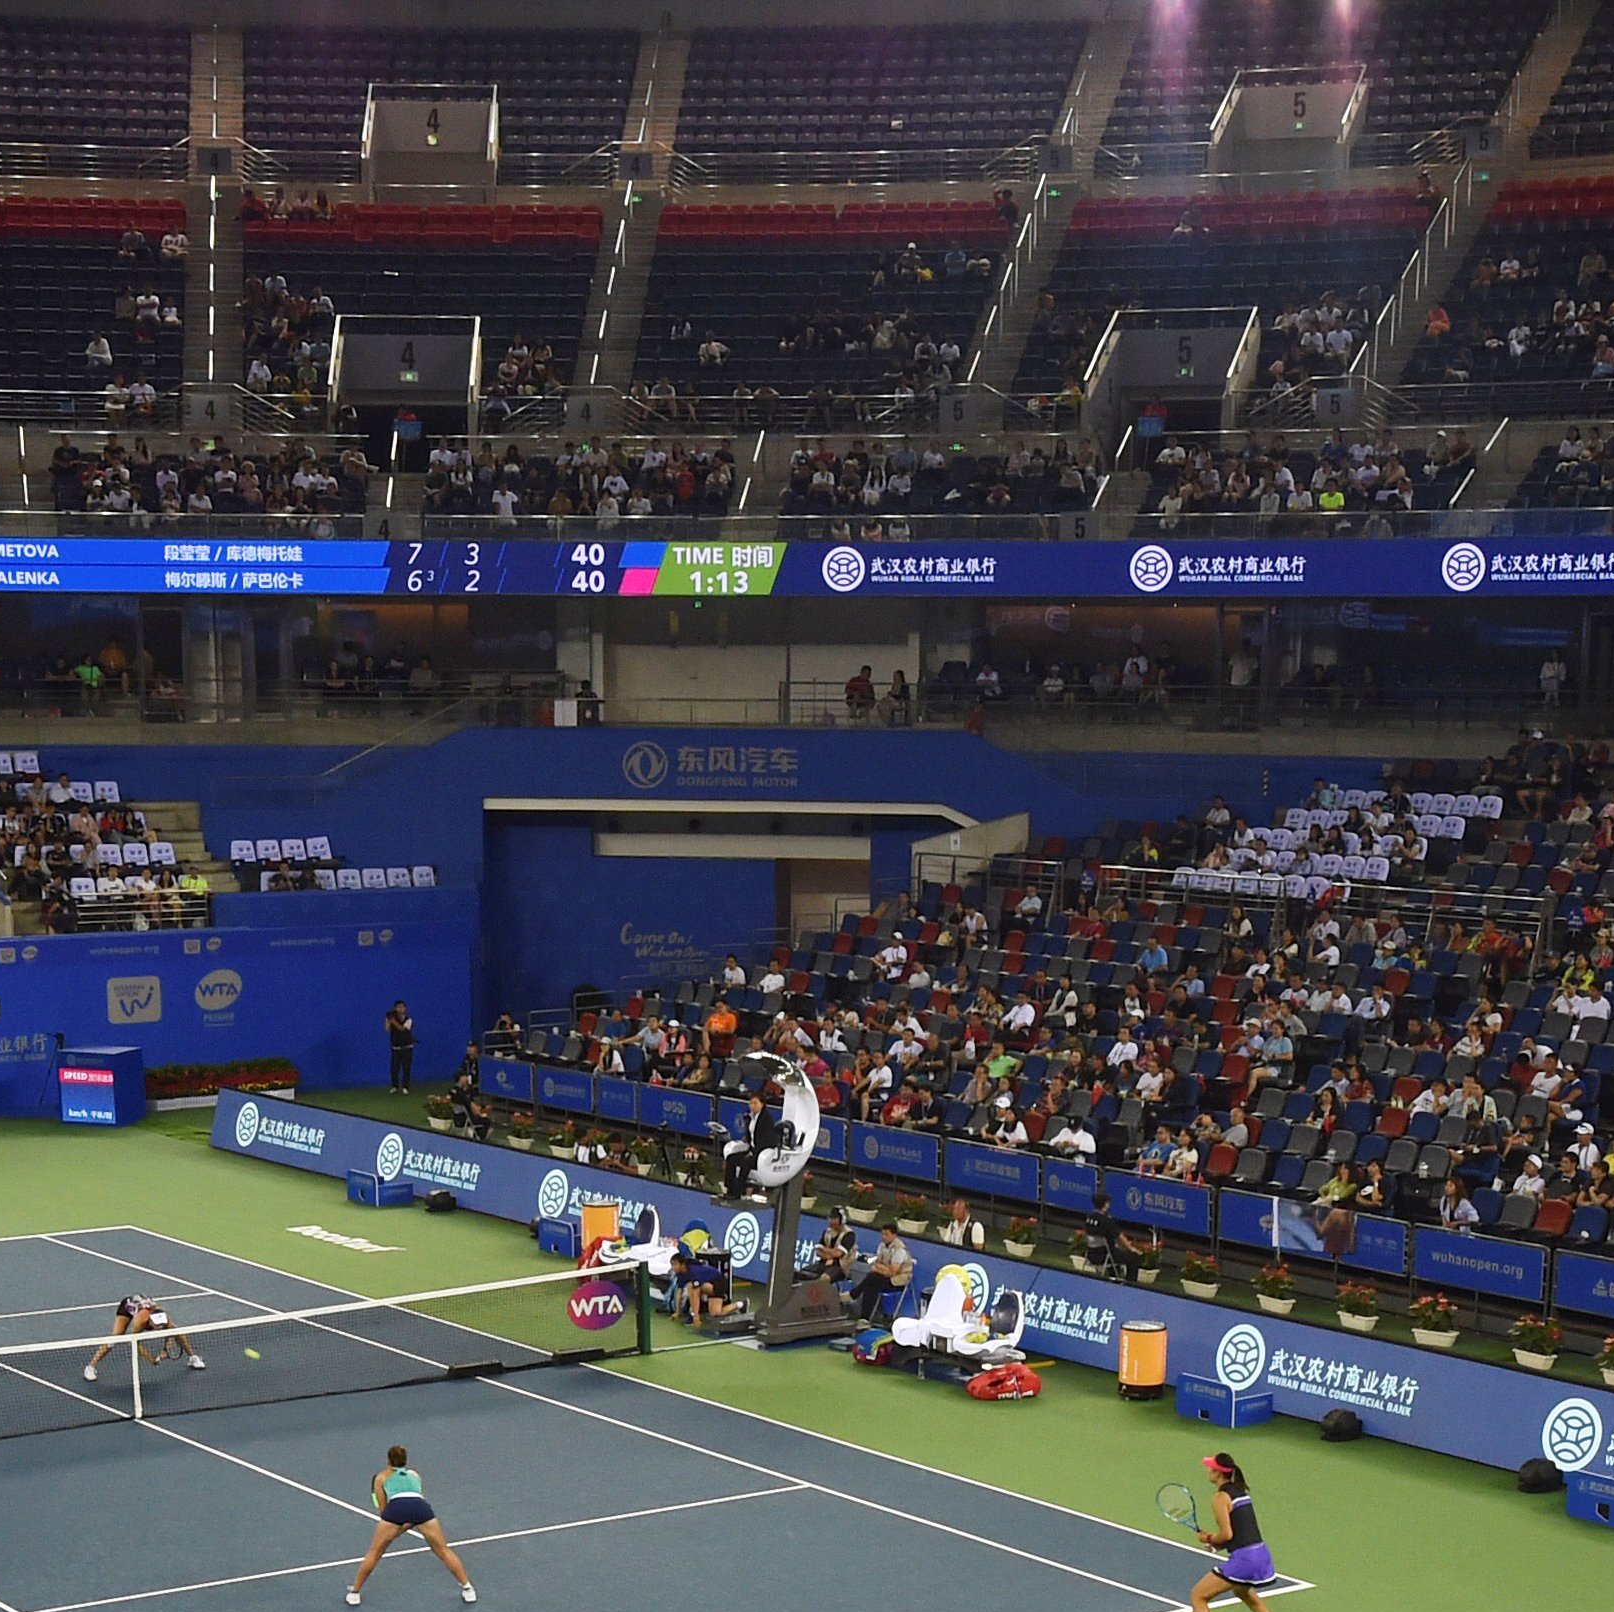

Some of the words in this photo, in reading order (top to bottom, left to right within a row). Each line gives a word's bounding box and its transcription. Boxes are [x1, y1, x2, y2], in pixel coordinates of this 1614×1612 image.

[1294, 92, 1306, 118] 5
[427, 108, 440, 133] 4
[401, 342, 416, 370] 4
[1178, 336, 1192, 364] 5
[1075, 517, 1085, 539] 5
[164, 545, 210, 561] 段莹莹
[214, 546, 222, 561] /
[408, 543, 422, 564] 7
[464, 543, 479, 565] 3
[571, 543, 604, 566] 40
[672, 547, 724, 564] TIME
[732, 545, 773, 568] 时间
[1179, 555, 1307, 574] 武汉农村商业银行
[872, 557, 997, 574] 武汉农村商业银行
[230, 573, 238, 588] /
[242, 572, 303, 589] 萨巴伦卡
[408, 570, 422, 591] 6
[465, 570, 480, 591] 2
[572, 570, 605, 592] 40
[690, 571, 748, 593] 1:13
[677, 747, 798, 773] 东风汽车
[677, 776, 746, 787] DONGFENG
[753, 776, 798, 787] MOTOR
[1431, 1251, 1524, 1280] wuhanopen.org
[571, 1295, 624, 1318] WTA
[1040, 1320, 1087, 1342] COMMERCIAL
[1088, 1332, 1110, 1345] BANK
[1269, 1348, 1419, 1404] 武汉农村商业银行
[1268, 1374, 1298, 1391] WUHAN
[1300, 1381, 1327, 1397] RURAL
[1329, 1388, 1384, 1410] COMMERCIAL
[1386, 1401, 1412, 1417] BANK
